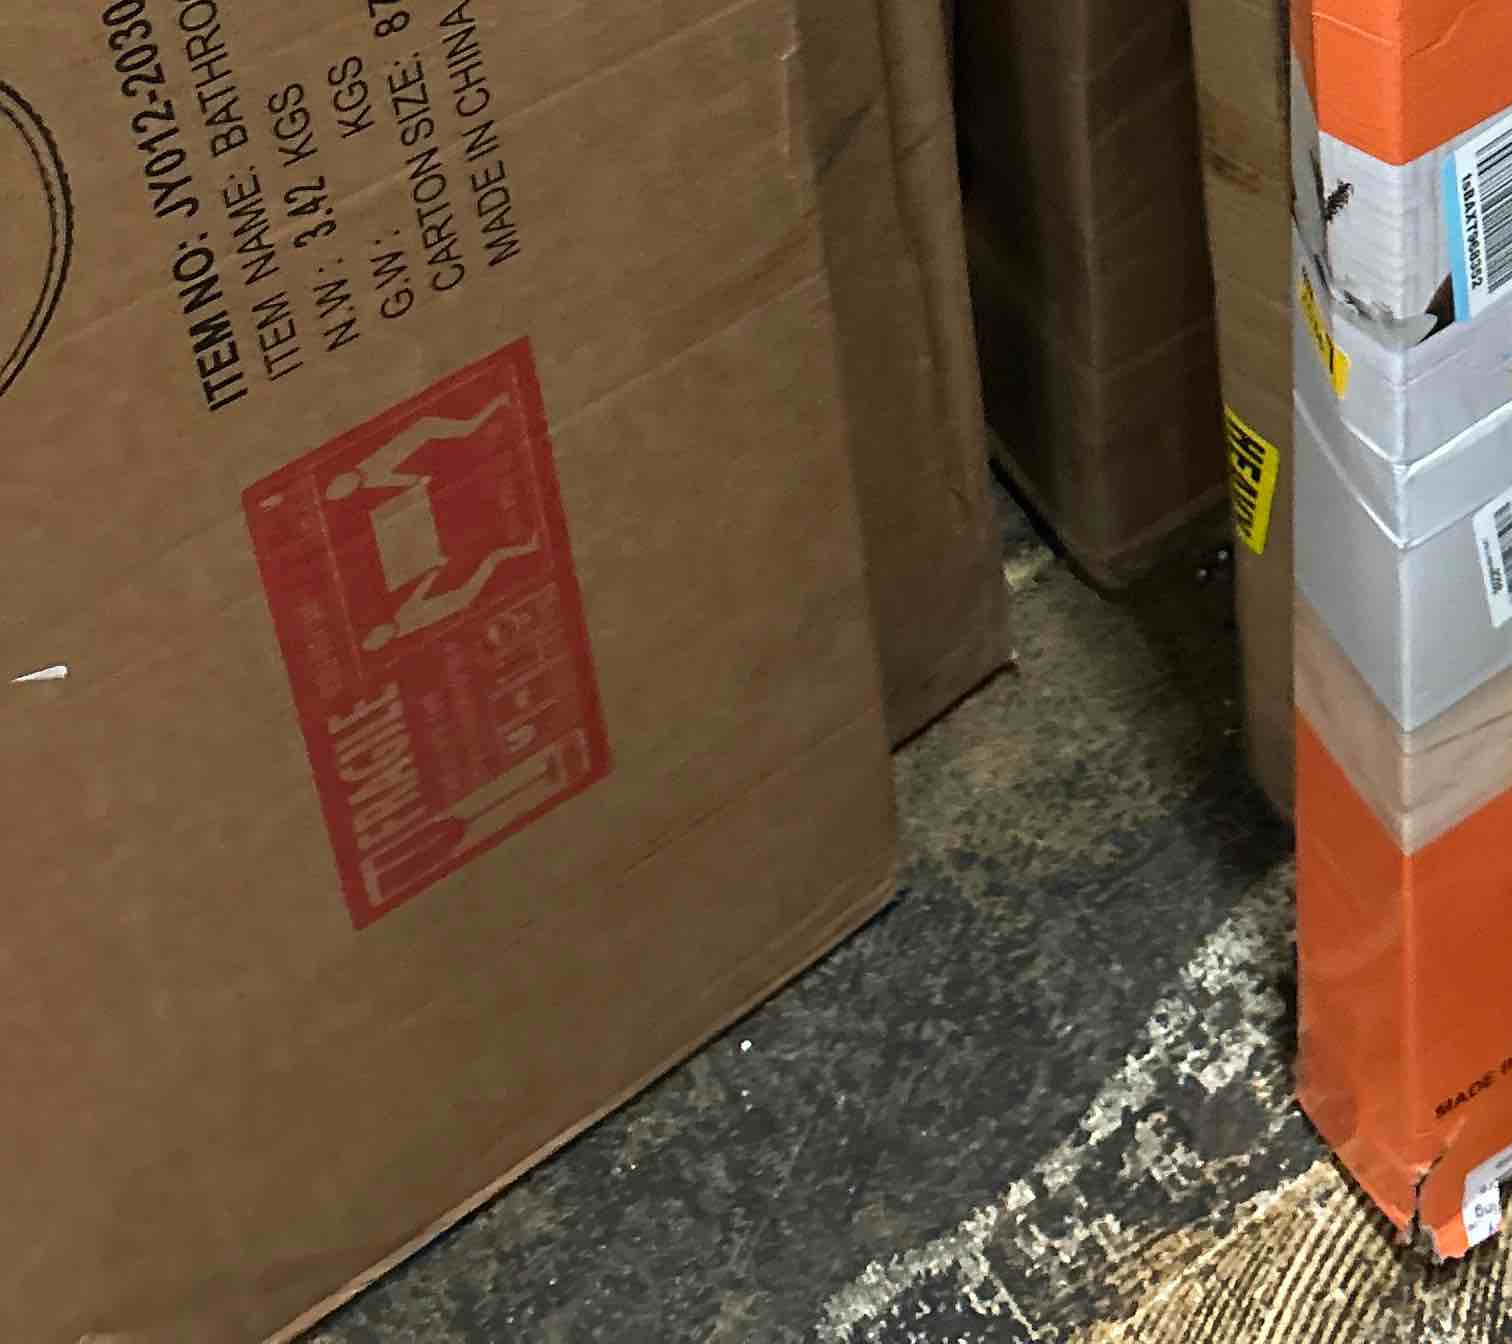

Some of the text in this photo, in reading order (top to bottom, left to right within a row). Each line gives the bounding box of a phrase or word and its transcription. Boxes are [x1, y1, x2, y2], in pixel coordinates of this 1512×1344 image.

[266, 82, 319, 168] KGS
[327, 55, 376, 140] KGS
[386, 51, 435, 147] SIZE:
[460, 119, 501, 163] IN
[221, 165, 281, 286] NAME:
[283, 175, 337, 249] 3.42
[404, 146, 465, 292] CARTON
[469, 159, 521, 268] MADE
[171, 231, 224, 315] NO:
[188, 309, 249, 413] ITEM
[251, 290, 304, 382] ITEM
